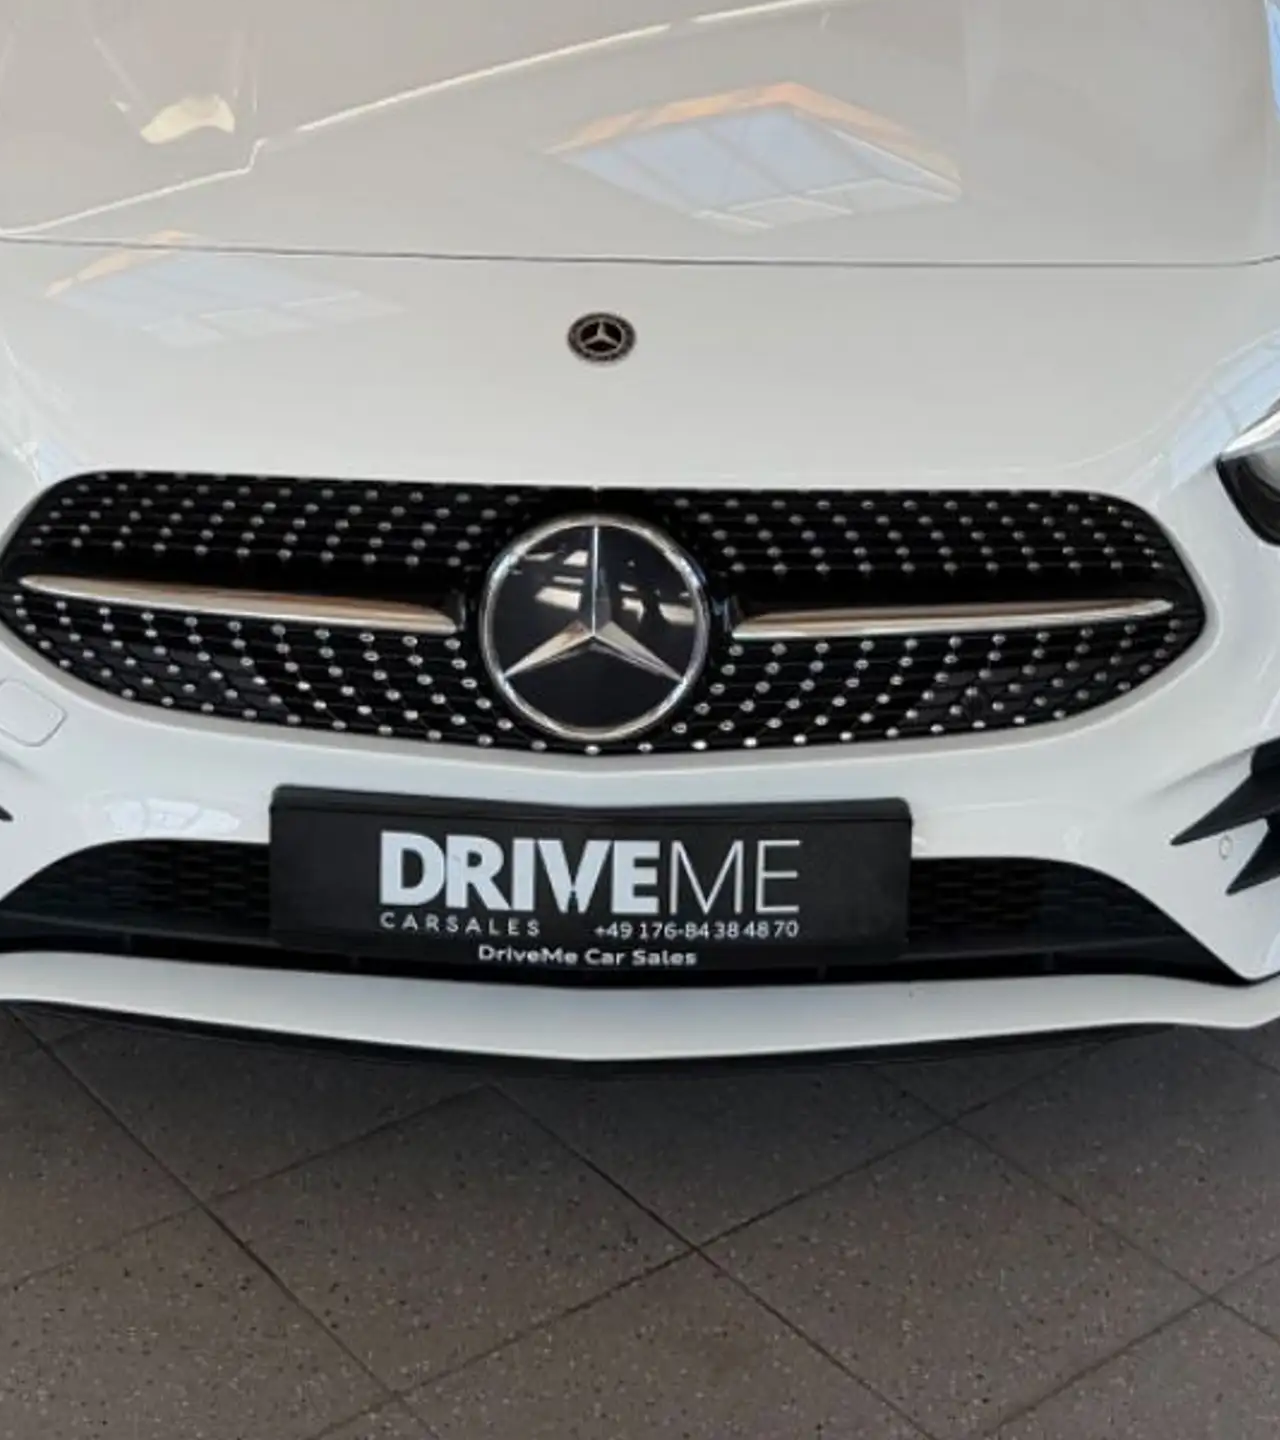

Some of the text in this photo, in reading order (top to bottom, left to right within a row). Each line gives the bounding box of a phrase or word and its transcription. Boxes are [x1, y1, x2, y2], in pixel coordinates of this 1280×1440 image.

[379, 829, 802, 916] DRIVEME
[379, 911, 541, 937] CARSALES
[594, 920, 634, 941] +49
[478, 944, 698, 967] DriveMe Car Sales
